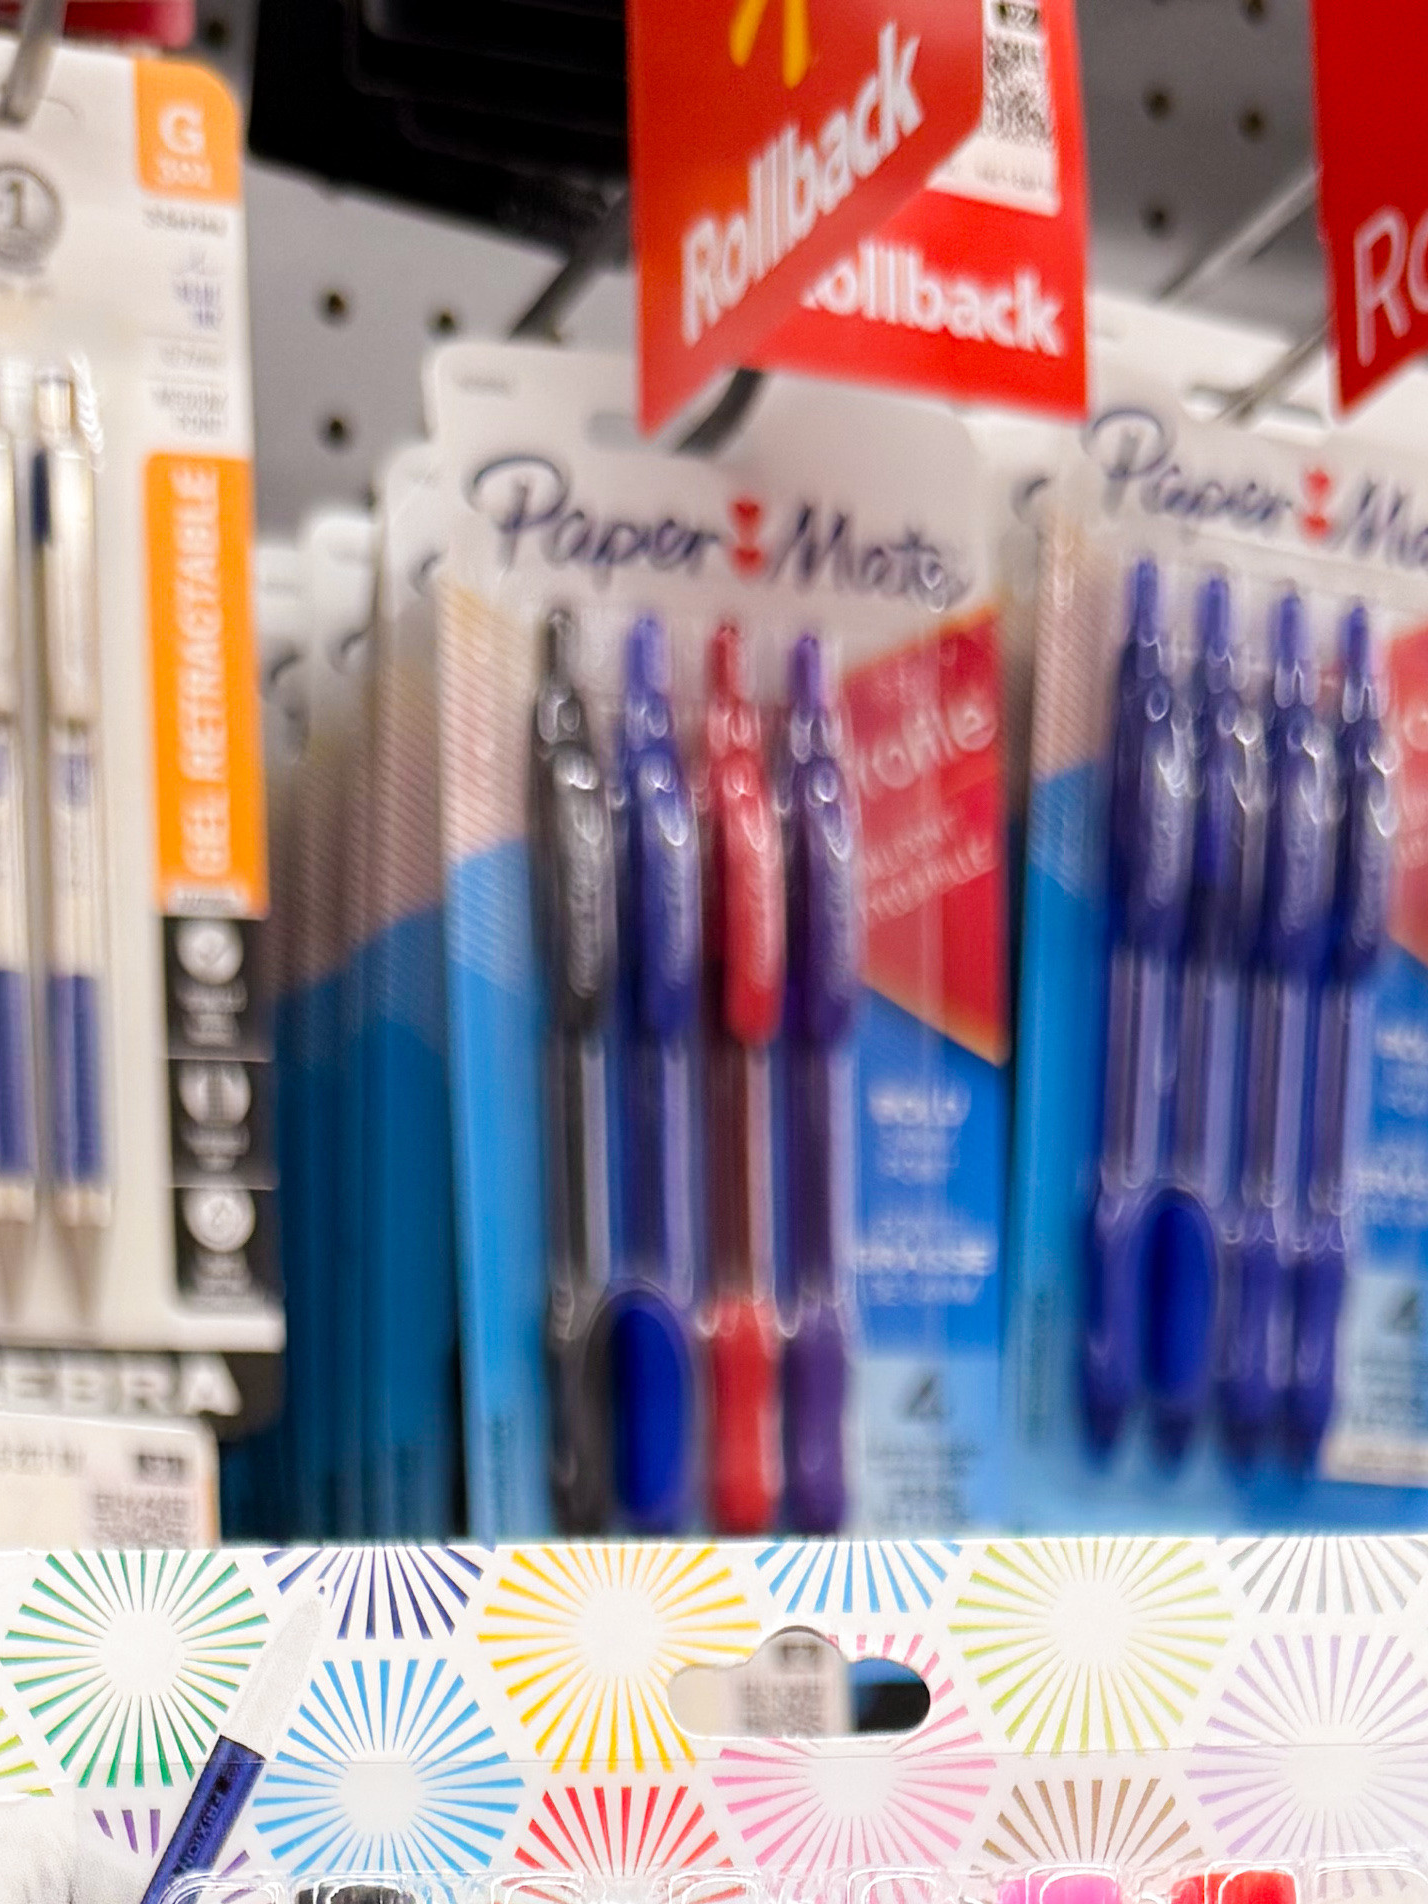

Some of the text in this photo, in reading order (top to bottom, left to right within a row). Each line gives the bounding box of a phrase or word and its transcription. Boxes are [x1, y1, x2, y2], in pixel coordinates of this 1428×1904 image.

[680, 21, 924, 348] Rollback
[799, 243, 1067, 357] ollback
[465, 455, 972, 608] Paper Mate
[1083, 408, 1294, 531] Paper
